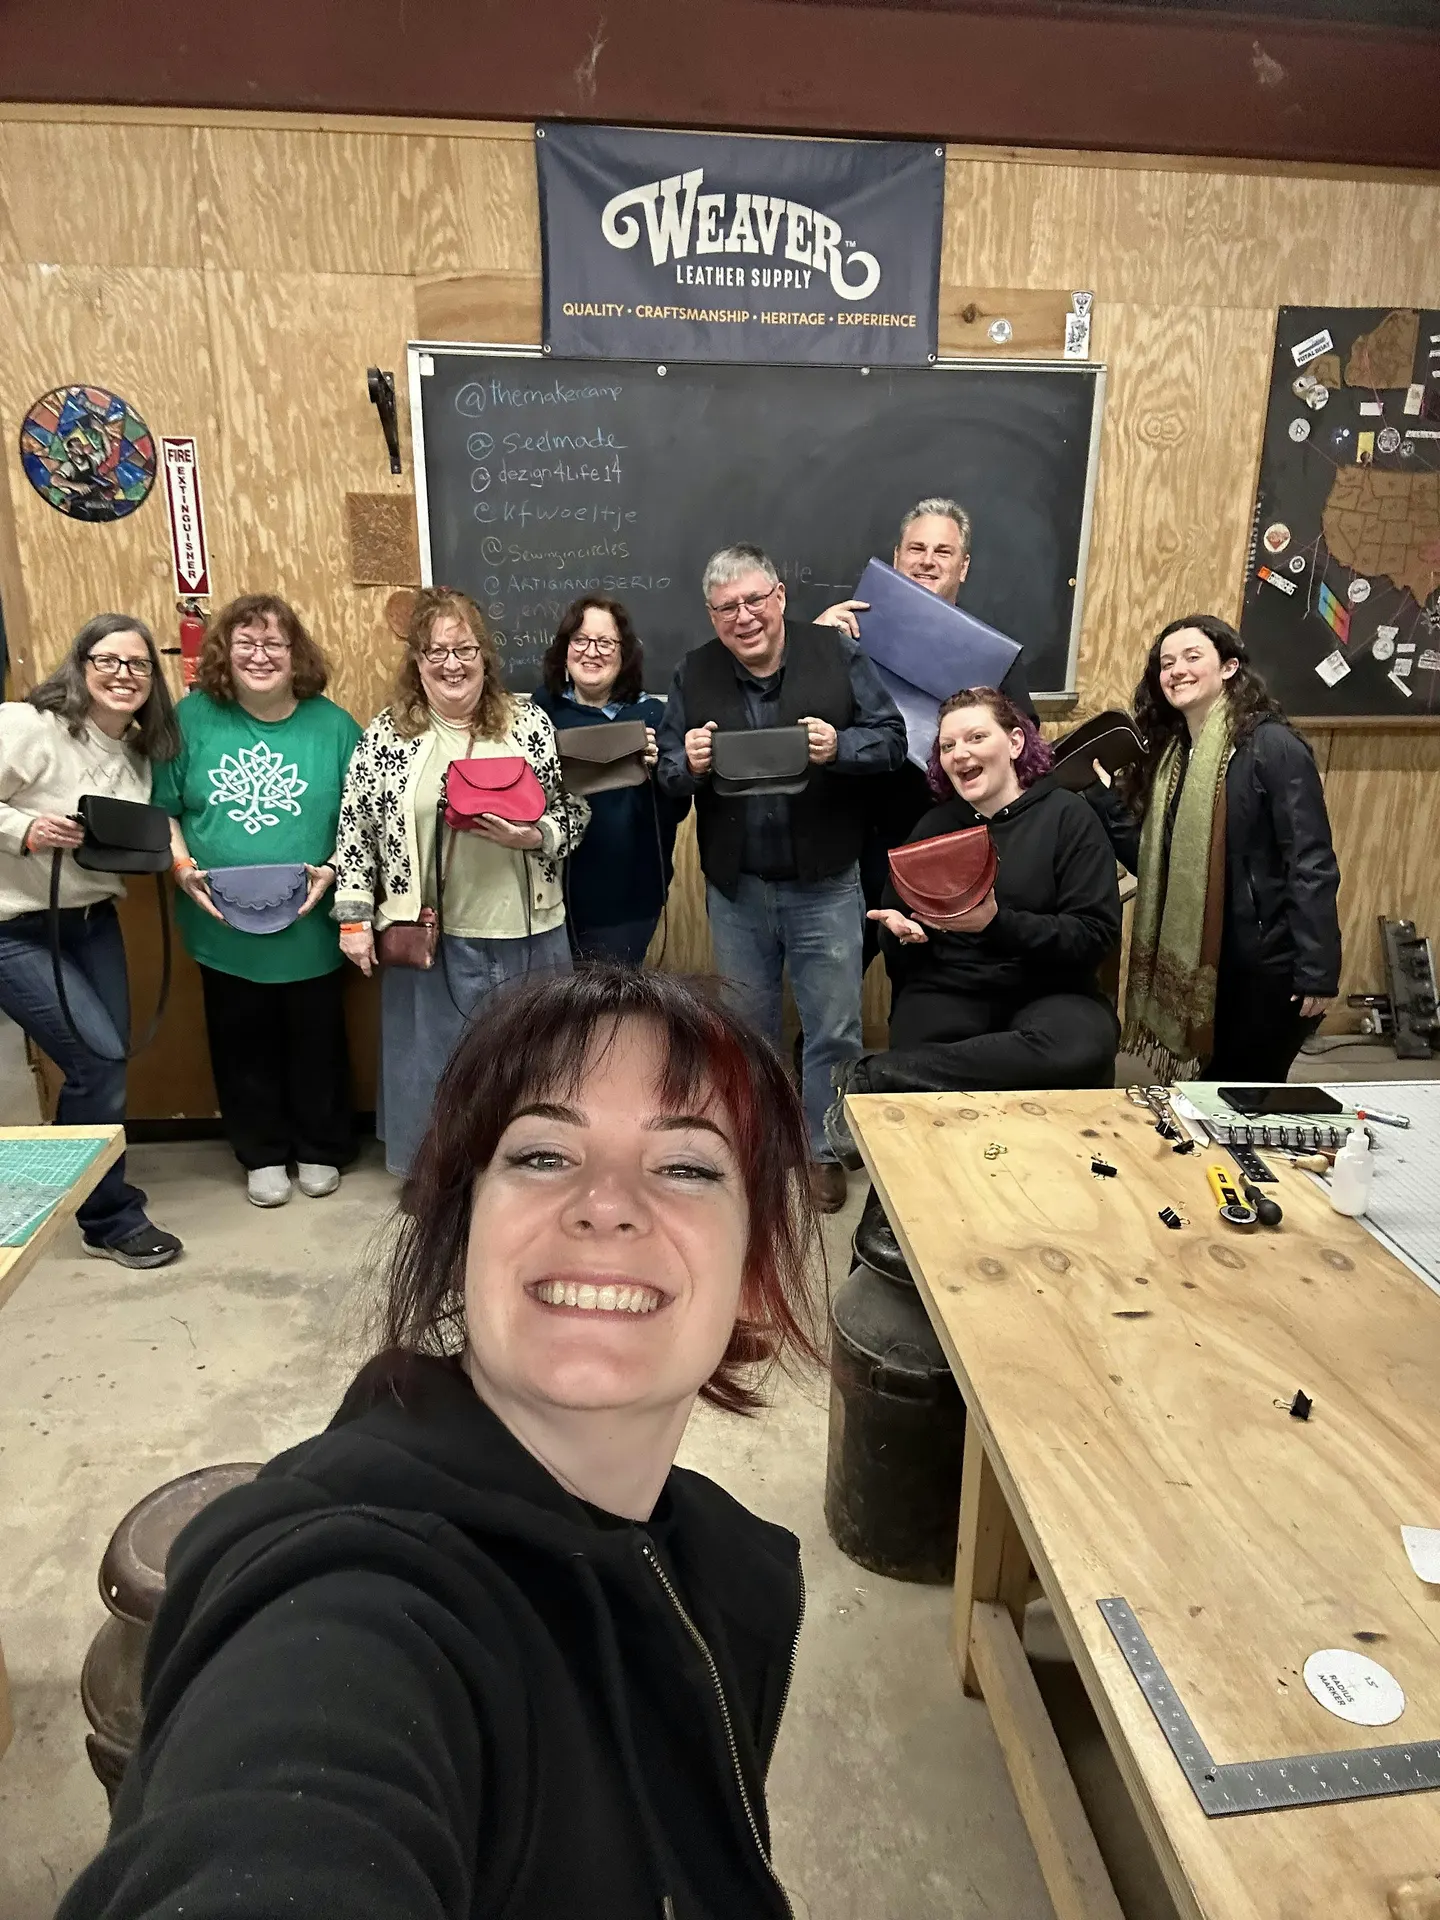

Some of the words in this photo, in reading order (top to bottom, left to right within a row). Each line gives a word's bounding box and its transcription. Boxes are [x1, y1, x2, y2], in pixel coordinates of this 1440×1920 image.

[602, 168, 881, 301] WEAVER
[676, 264, 745, 288] LEATHER
[751, 267, 812, 289] SUPPLY
[562, 302, 624, 318] QUALITY
[635, 305, 750, 324] CRAFTSMANSHIP
[760, 311, 826, 326] HERITAGE
[837, 313, 917, 328] EXPERIENCE
[167, 448, 193, 463] FIRE
[176, 466, 197, 579] EXTINGUISHER
[1317, 1673, 1346, 1706] MARKER
[1328, 1674, 1355, 1703] RADIUS
